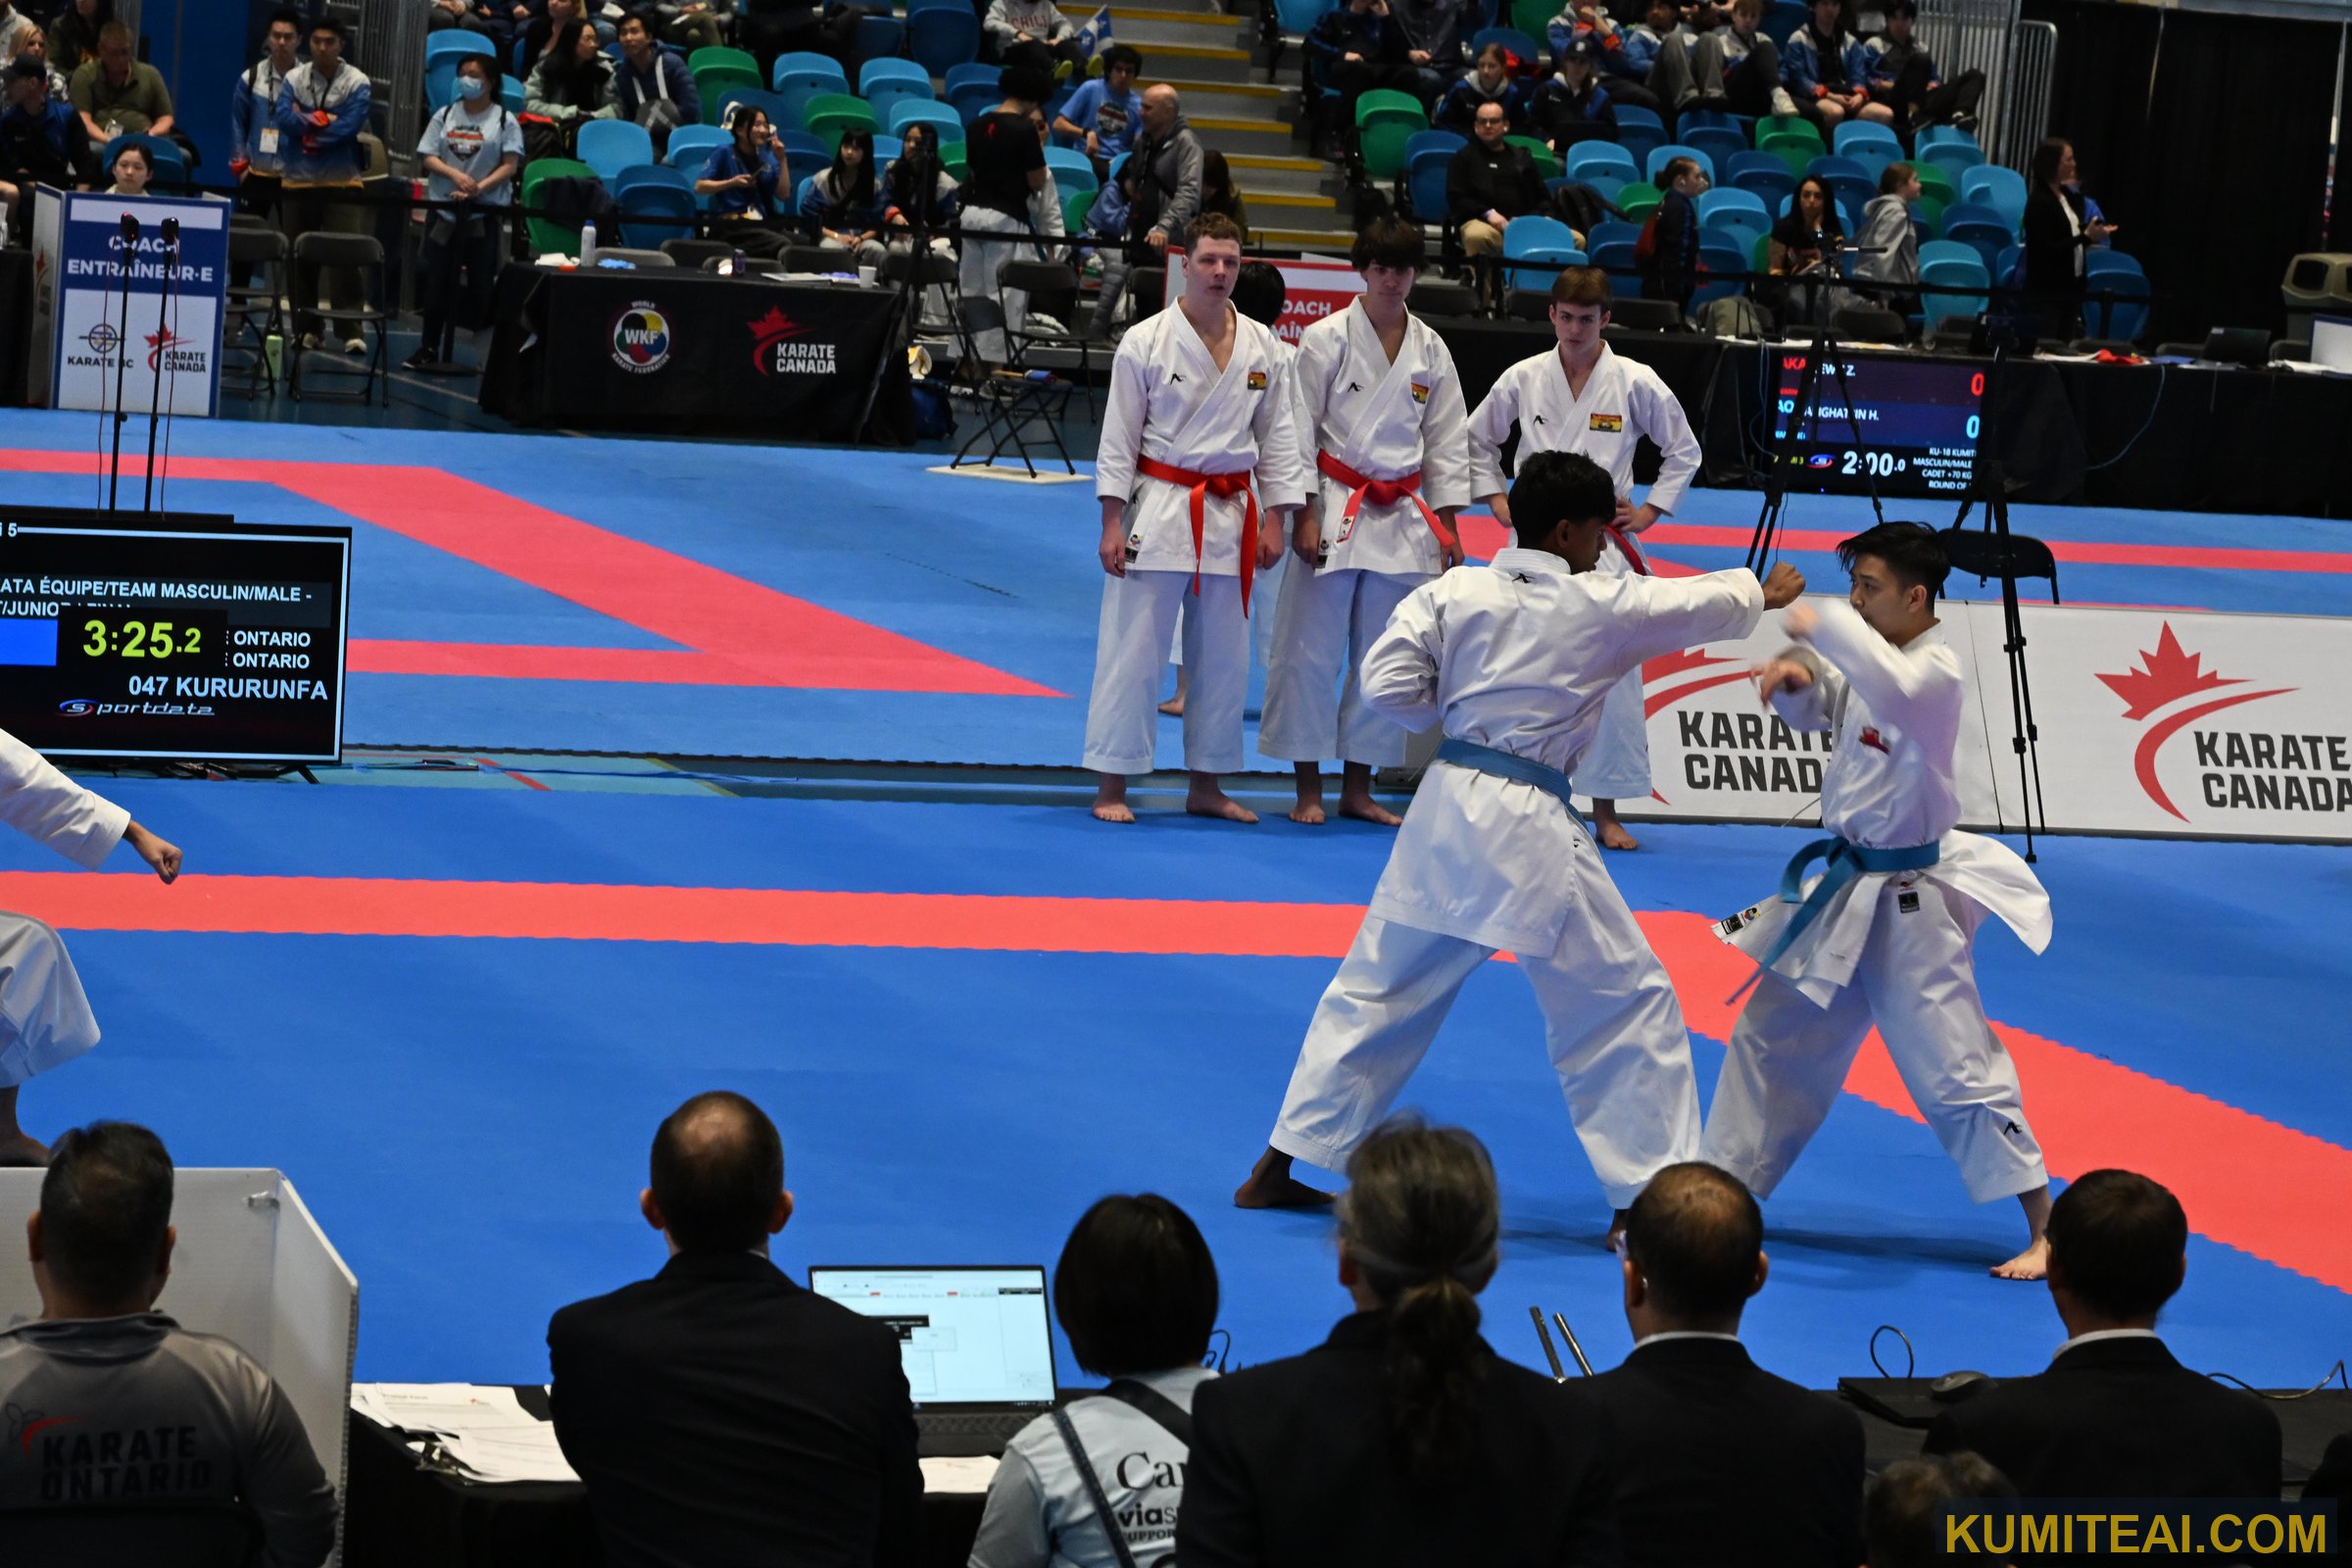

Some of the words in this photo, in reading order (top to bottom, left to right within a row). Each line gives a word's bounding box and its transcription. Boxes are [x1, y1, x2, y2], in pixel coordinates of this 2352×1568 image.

[1283, 301, 1331, 316] OACH
[624, 328, 659, 344] WKF
[165, 351, 206, 362] KARATE
[777, 343, 836, 359] KARATE
[68, 356, 115, 368] KARATE
[165, 363, 206, 372] CANADA
[776, 359, 837, 373] CANADA
[1971, 372, 1984, 396] 0
[1966, 415, 1980, 438] 0
[1913, 458, 1972, 468] MASCULIN/MALE
[1922, 468, 1945, 478] CADET
[1929, 480, 1956, 489] ROUND
[8, 522, 18, 537] 5
[0, 578, 34, 594] ATA
[39, 575, 156, 598] ÉQUIPE/TEAM
[161, 582, 301, 602] MASCULIN/MALE
[83, 619, 201, 659] 3:25.2
[233, 630, 311, 647] ONTARIO
[232, 653, 310, 669] ONTARIO
[128, 675, 169, 696] 047
[175, 676, 328, 701] KURURUNFA
[2193, 731, 2351, 771] KARATE
[1684, 754, 1831, 794] CANAD
[2202, 773, 2352, 812] CANADA
[43, 1425, 196, 1468] KARATE
[41, 1459, 211, 1501] ONTARIO
[1118, 1501, 1176, 1528] vias
